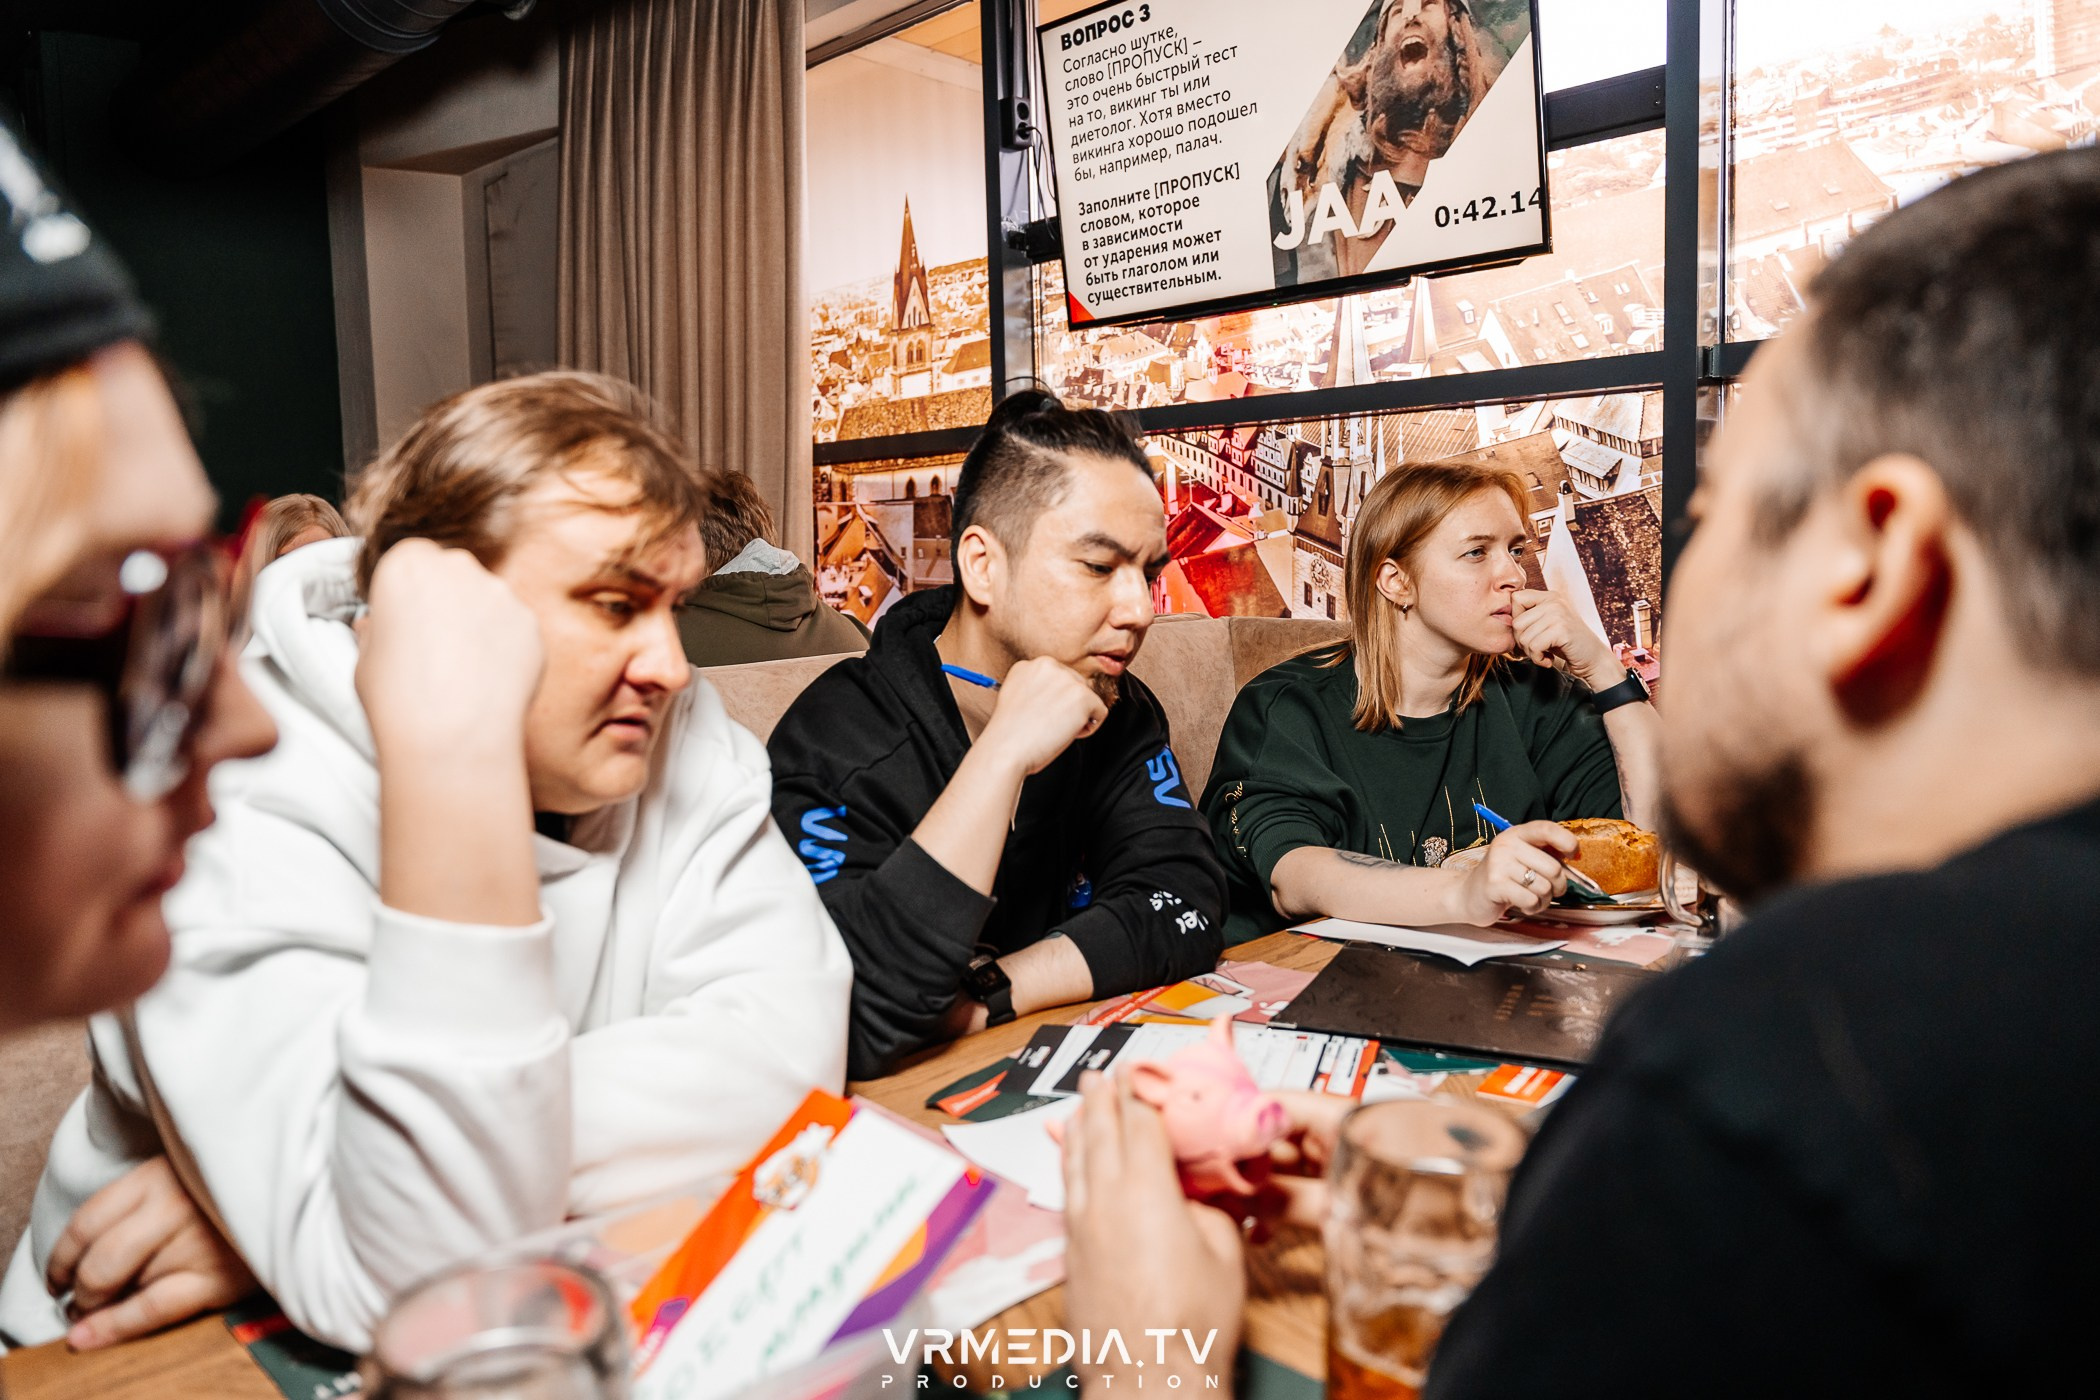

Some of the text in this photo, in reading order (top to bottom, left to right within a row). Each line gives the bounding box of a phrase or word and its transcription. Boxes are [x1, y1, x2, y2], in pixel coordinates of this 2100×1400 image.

[1061, 4, 1151, 51] ВОПРОС 3
[1063, 26, 1178, 74] Согласно шутке,
[1065, 71, 1104, 91] слово
[1108, 37, 1188, 79] [ПРОПУСК]
[1066, 45, 1238, 110] это очень быстрый тест
[1069, 75, 1210, 128] на то, викинг ты или
[1071, 89, 1231, 148] диетолог. Хотя вместо
[1073, 102, 1258, 164] викинга хорошо подошел
[1074, 133, 1222, 181] бы, например, палач.
[1078, 162, 1240, 216] Заполните [ПРОПУСК]
[1272, 169, 1407, 251] JAA
[1080, 196, 1200, 233] словом, которое
[1082, 220, 1183, 251] в зависимости
[1084, 230, 1222, 268] от ударения может
[1085, 250, 1219, 286] быть глаголом или
[1087, 270, 1221, 306] существительным.
